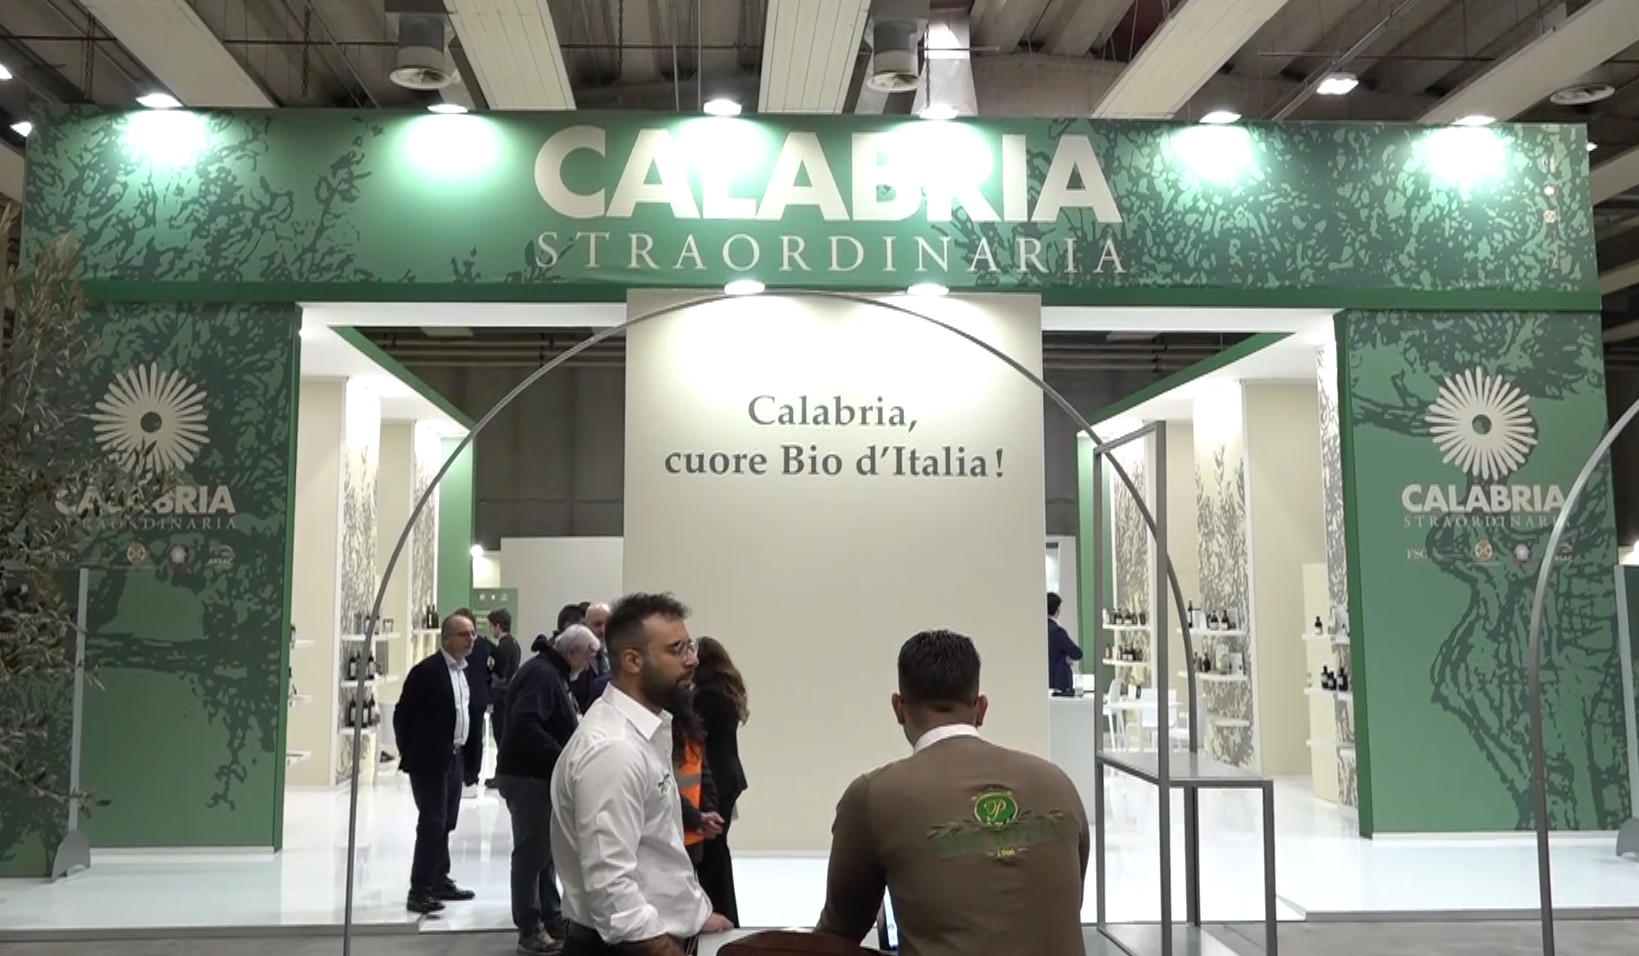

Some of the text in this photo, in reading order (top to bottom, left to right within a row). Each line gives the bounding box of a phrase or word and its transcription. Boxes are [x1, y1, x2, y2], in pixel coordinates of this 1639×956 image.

[534, 125, 1122, 224] CALABRIA
[535, 231, 1127, 274] STRAORDINARIA
[748, 395, 918, 433] Calabria,
[664, 450, 767, 475] cuore
[781, 445, 842, 475] Bio
[1401, 483, 1566, 514] CALABRIA
